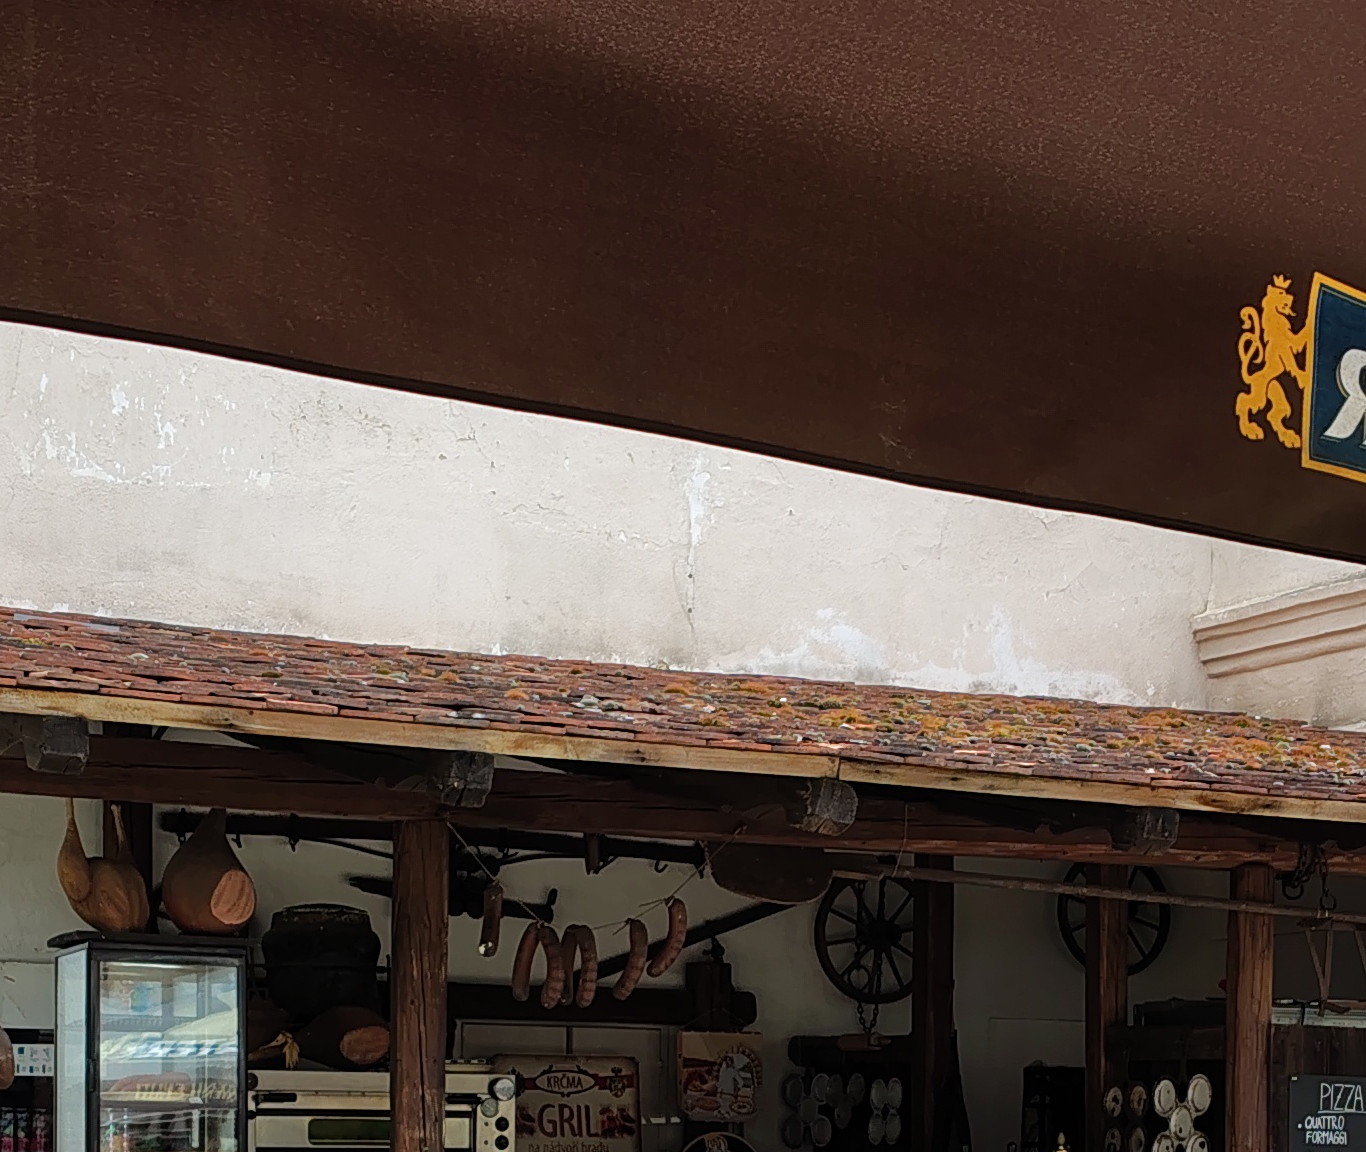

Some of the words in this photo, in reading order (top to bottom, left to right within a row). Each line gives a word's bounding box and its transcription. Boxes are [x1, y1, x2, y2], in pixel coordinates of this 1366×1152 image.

[546, 1073, 584, 1091] KRČMA
[1319, 1082, 1365, 1111] PIZZA
[537, 1103, 601, 1138] GRIL
[1304, 1115, 1345, 1130] QUATTRO
[1305, 1131, 1348, 1145] FORMAGGI
[528, 1143, 540, 1152] na
